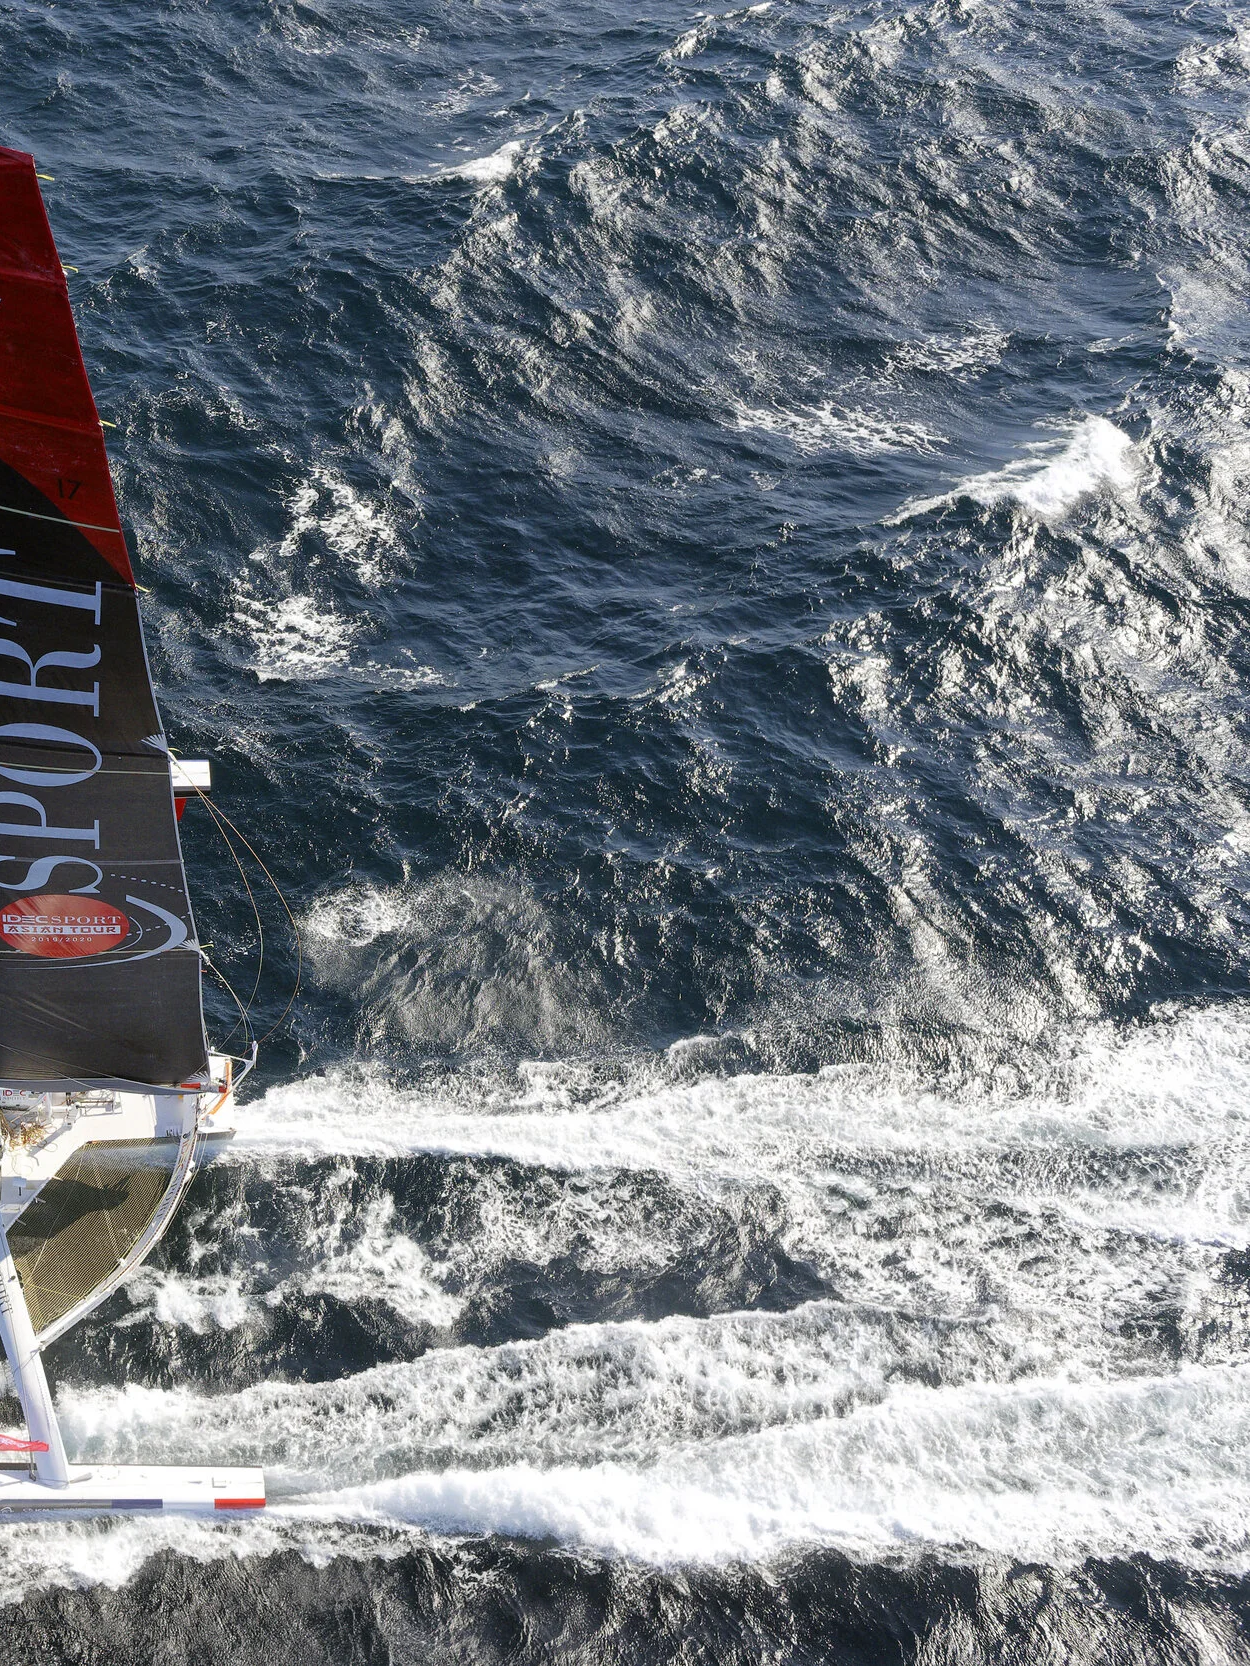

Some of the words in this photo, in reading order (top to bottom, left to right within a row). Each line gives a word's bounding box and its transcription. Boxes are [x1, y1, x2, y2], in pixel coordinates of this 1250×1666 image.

[58, 478, 82, 500] 17
[8, 926, 63, 934] ASIAN
[70, 926, 117, 934] TOUR
